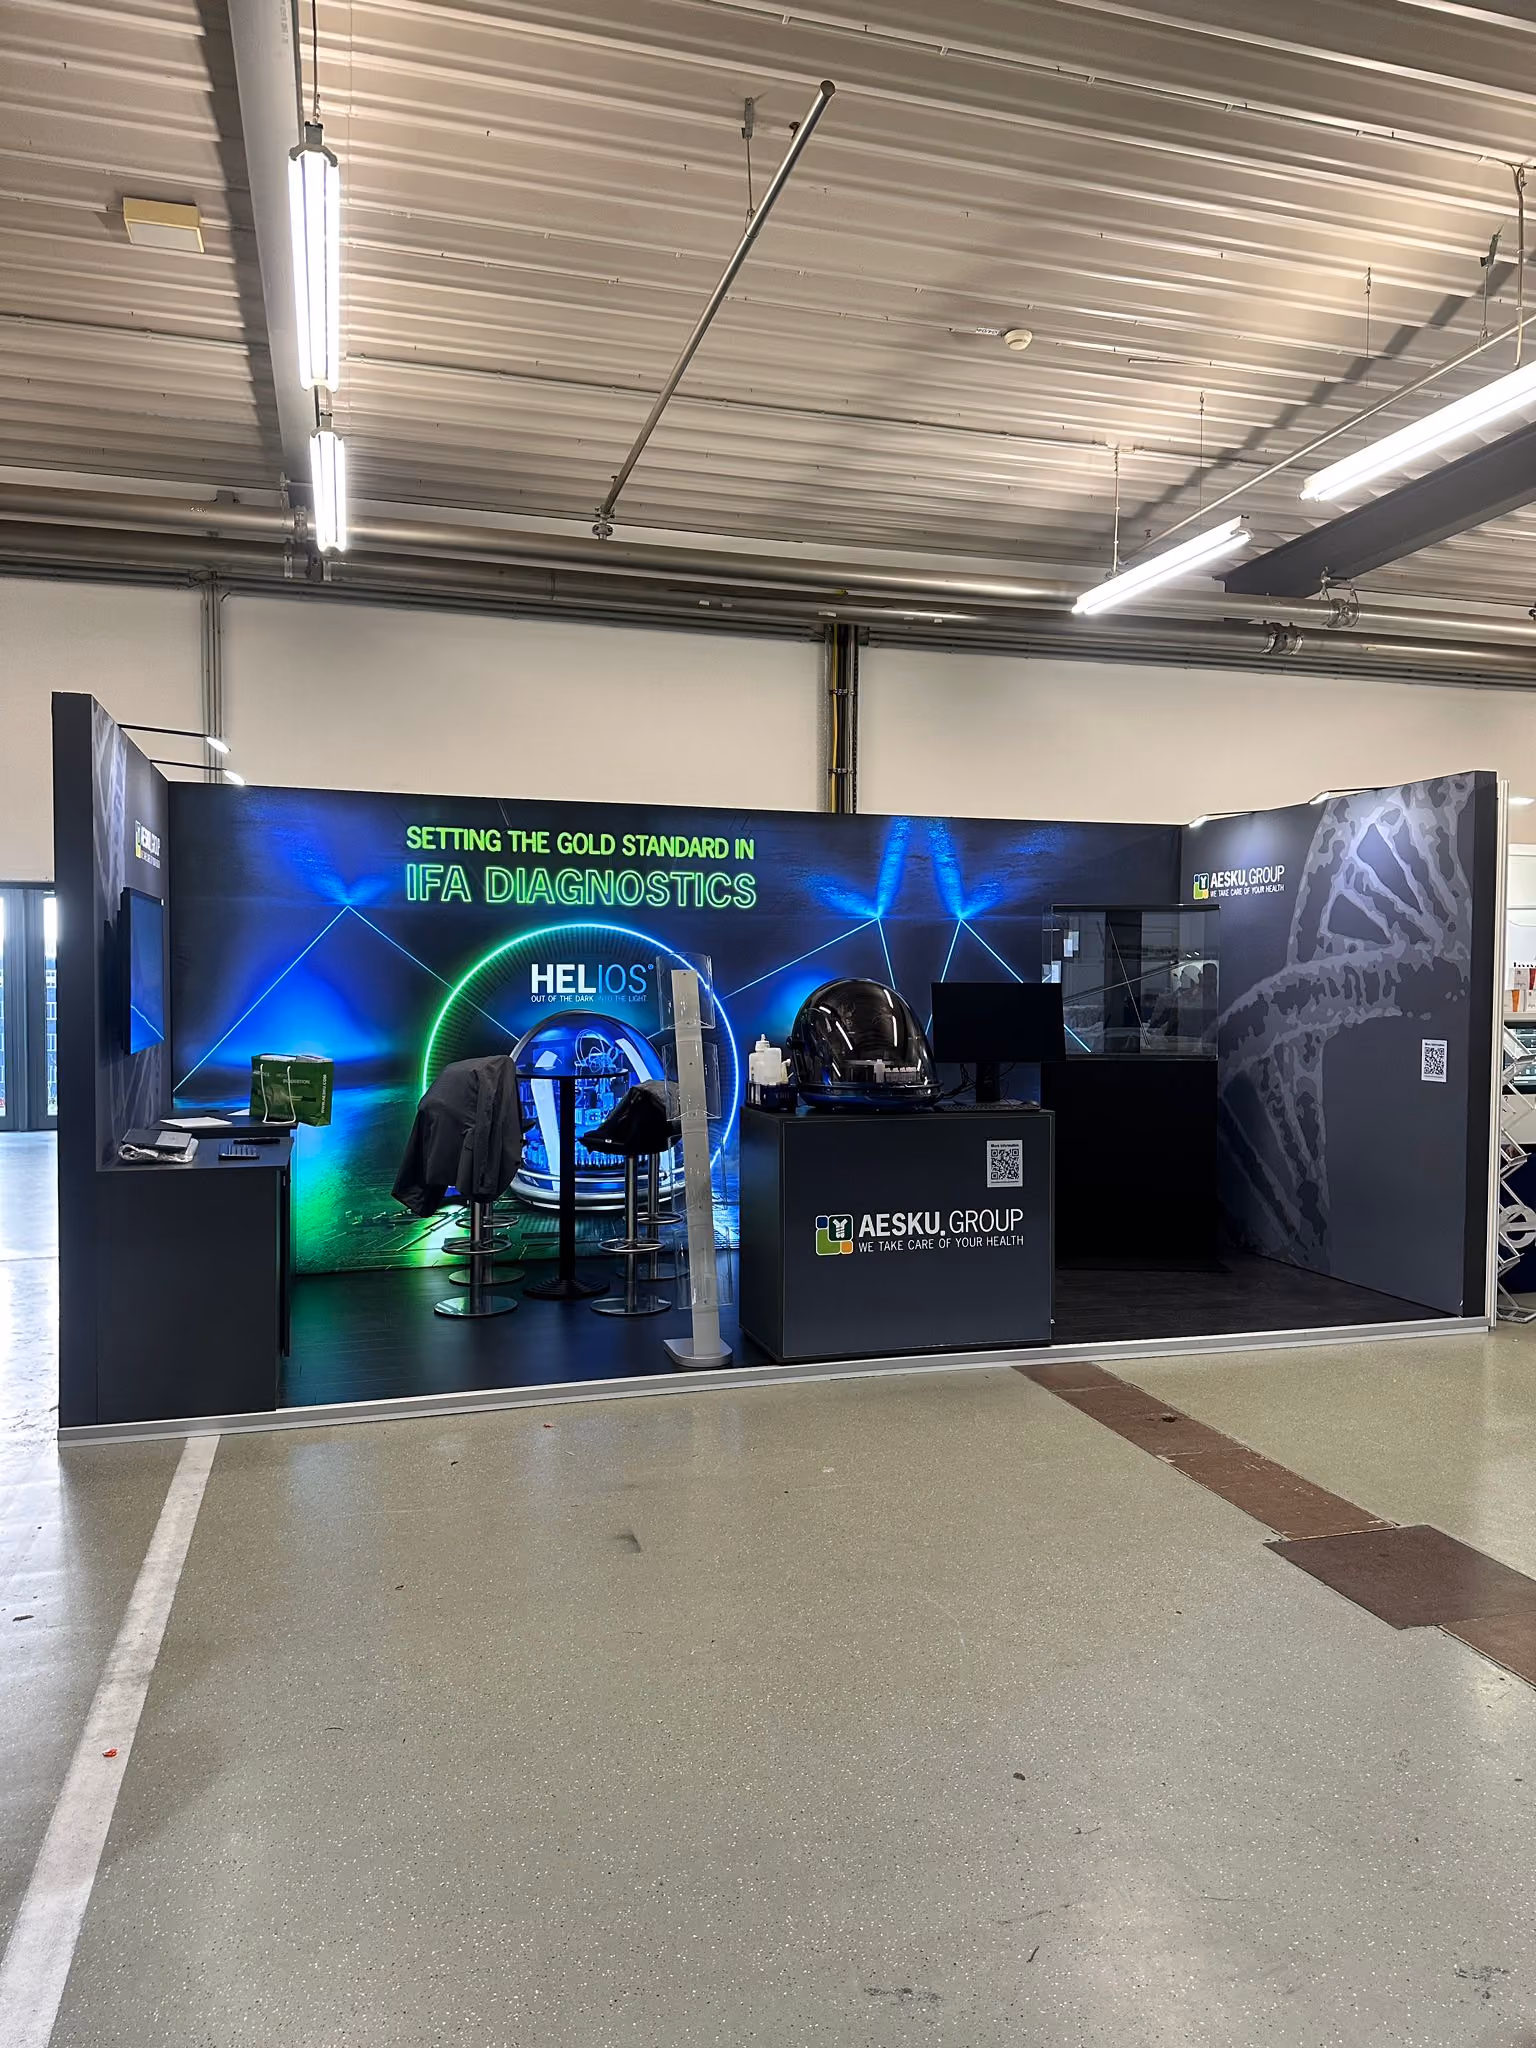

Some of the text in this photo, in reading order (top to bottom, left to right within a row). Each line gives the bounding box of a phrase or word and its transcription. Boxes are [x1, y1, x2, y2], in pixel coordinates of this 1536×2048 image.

[406, 825, 755, 860] SETTING THE GOLD STANDARD IN
[406, 863, 757, 909] IFA DIAGNOSTICS
[1218, 889, 1229, 897] TAKE
[1231, 888, 1242, 897] CARE
[1244, 887, 1250, 896] OF
[1252, 885, 1264, 894] YOUR
[1266, 883, 1285, 893] HEALTH
[858, 1235, 1024, 1253] WE TAKE CARE OF YOUR HEALTH
